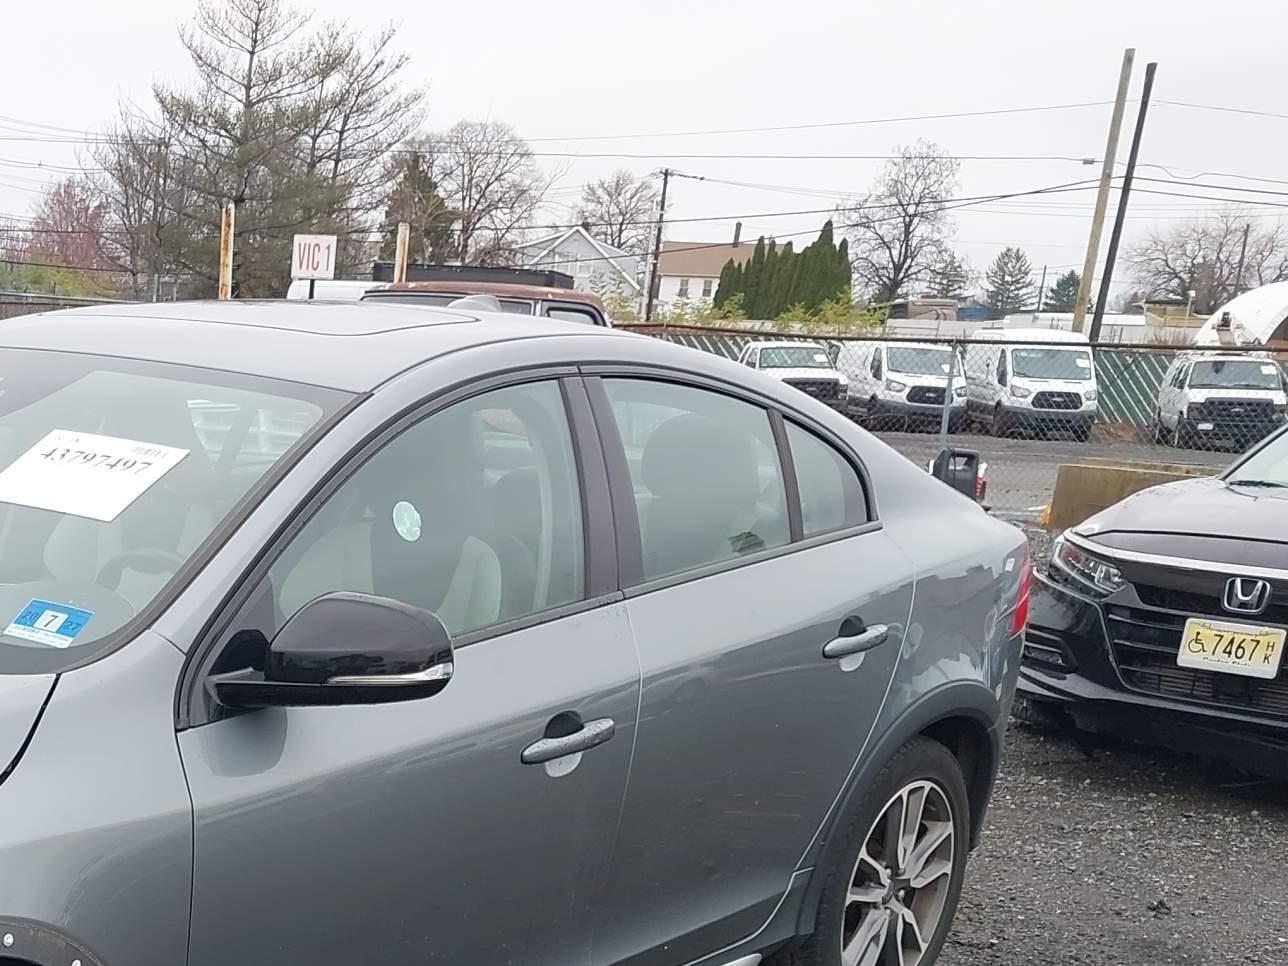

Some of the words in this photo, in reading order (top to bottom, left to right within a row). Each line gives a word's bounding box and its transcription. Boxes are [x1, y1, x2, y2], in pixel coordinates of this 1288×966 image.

[298, 242, 320, 271] VIC
[325, 243, 332, 271] 1
[40, 446, 154, 474] 43797497
[44, 613, 59, 628] 7
[64, 620, 82, 631] 27
[1211, 633, 1261, 662] 7467
